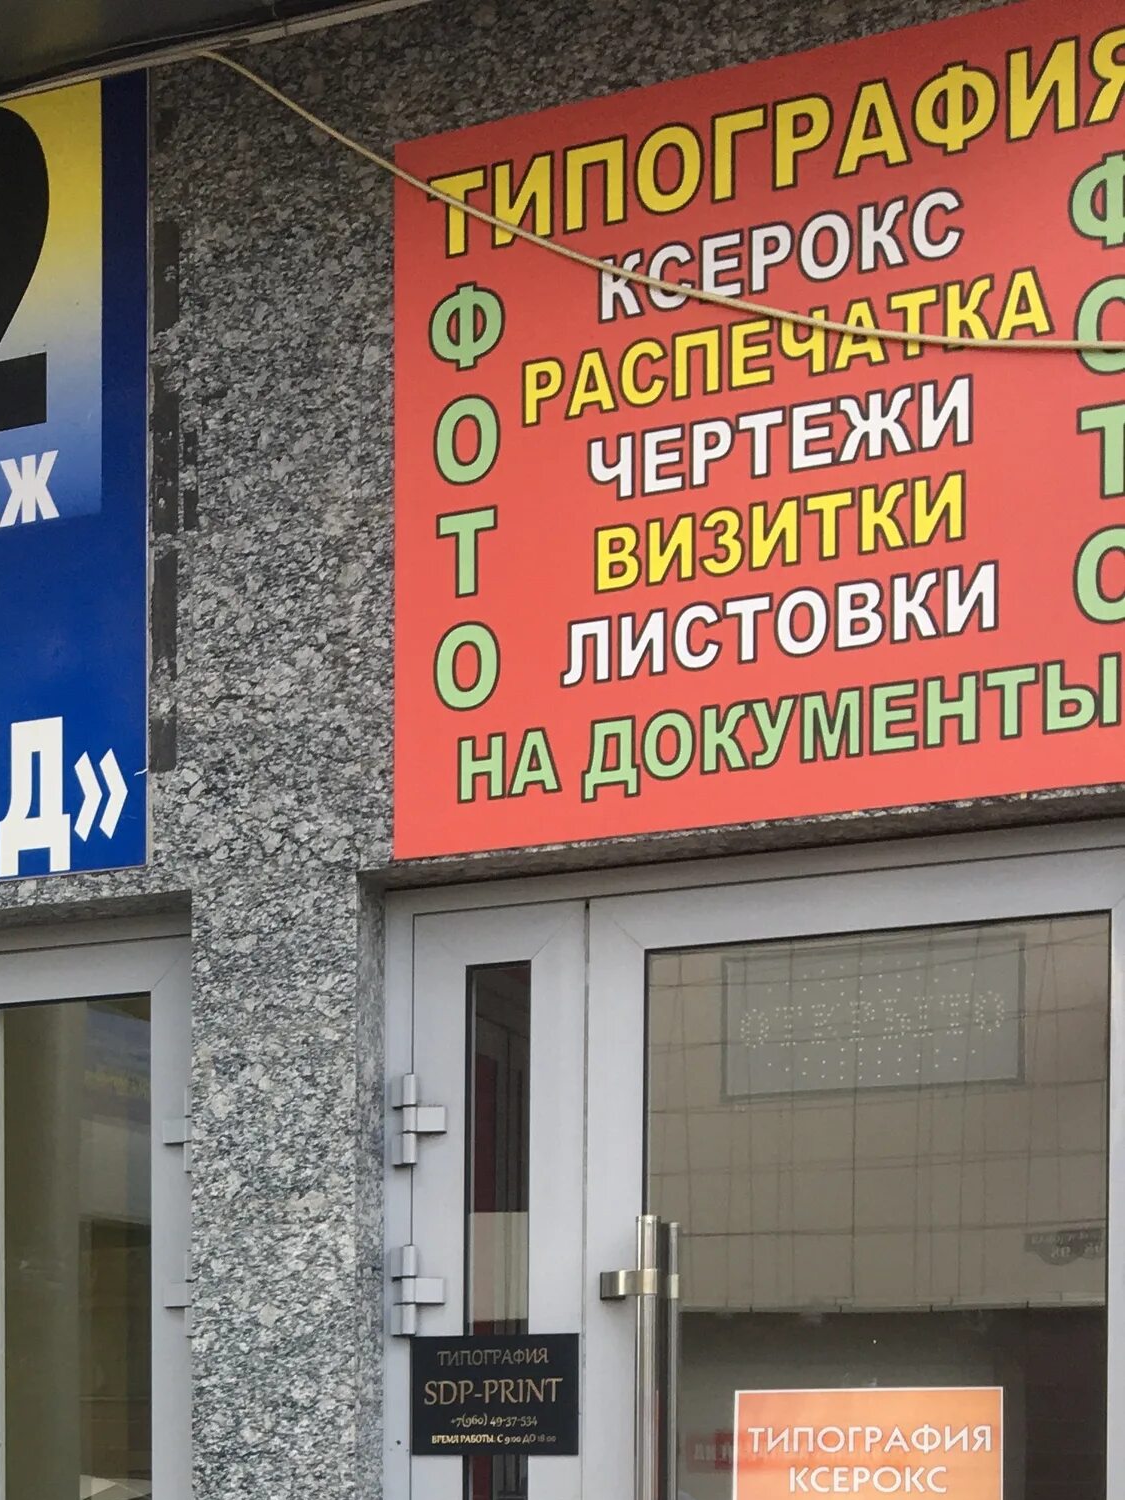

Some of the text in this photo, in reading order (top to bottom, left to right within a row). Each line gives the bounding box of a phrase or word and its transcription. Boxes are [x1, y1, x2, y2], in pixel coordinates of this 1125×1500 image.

[427, 25, 1125, 259] ТИПОГРАФИЯ
[598, 187, 964, 324] КСЕРОКС
[521, 266, 1055, 427] РАСПЕЧАТКА
[428, 281, 506, 714] ФОТО
[587, 375, 974, 501] ЧЕРТЕЖИ
[594, 471, 967, 595] ВИЗИТКИ
[560, 560, 999, 688] ЛИСТОВКИ
[457, 652, 1122, 804] НА ДОКУМЕНТЫ
[424, 1378, 563, 1405] SDP-PRINT
[437, 1348, 549, 1366] ТИПОГРАФИЯ
[747, 1424, 992, 1454] ТИПОГРАФИЯ
[789, 1466, 948, 1493] КСЕРОКС
